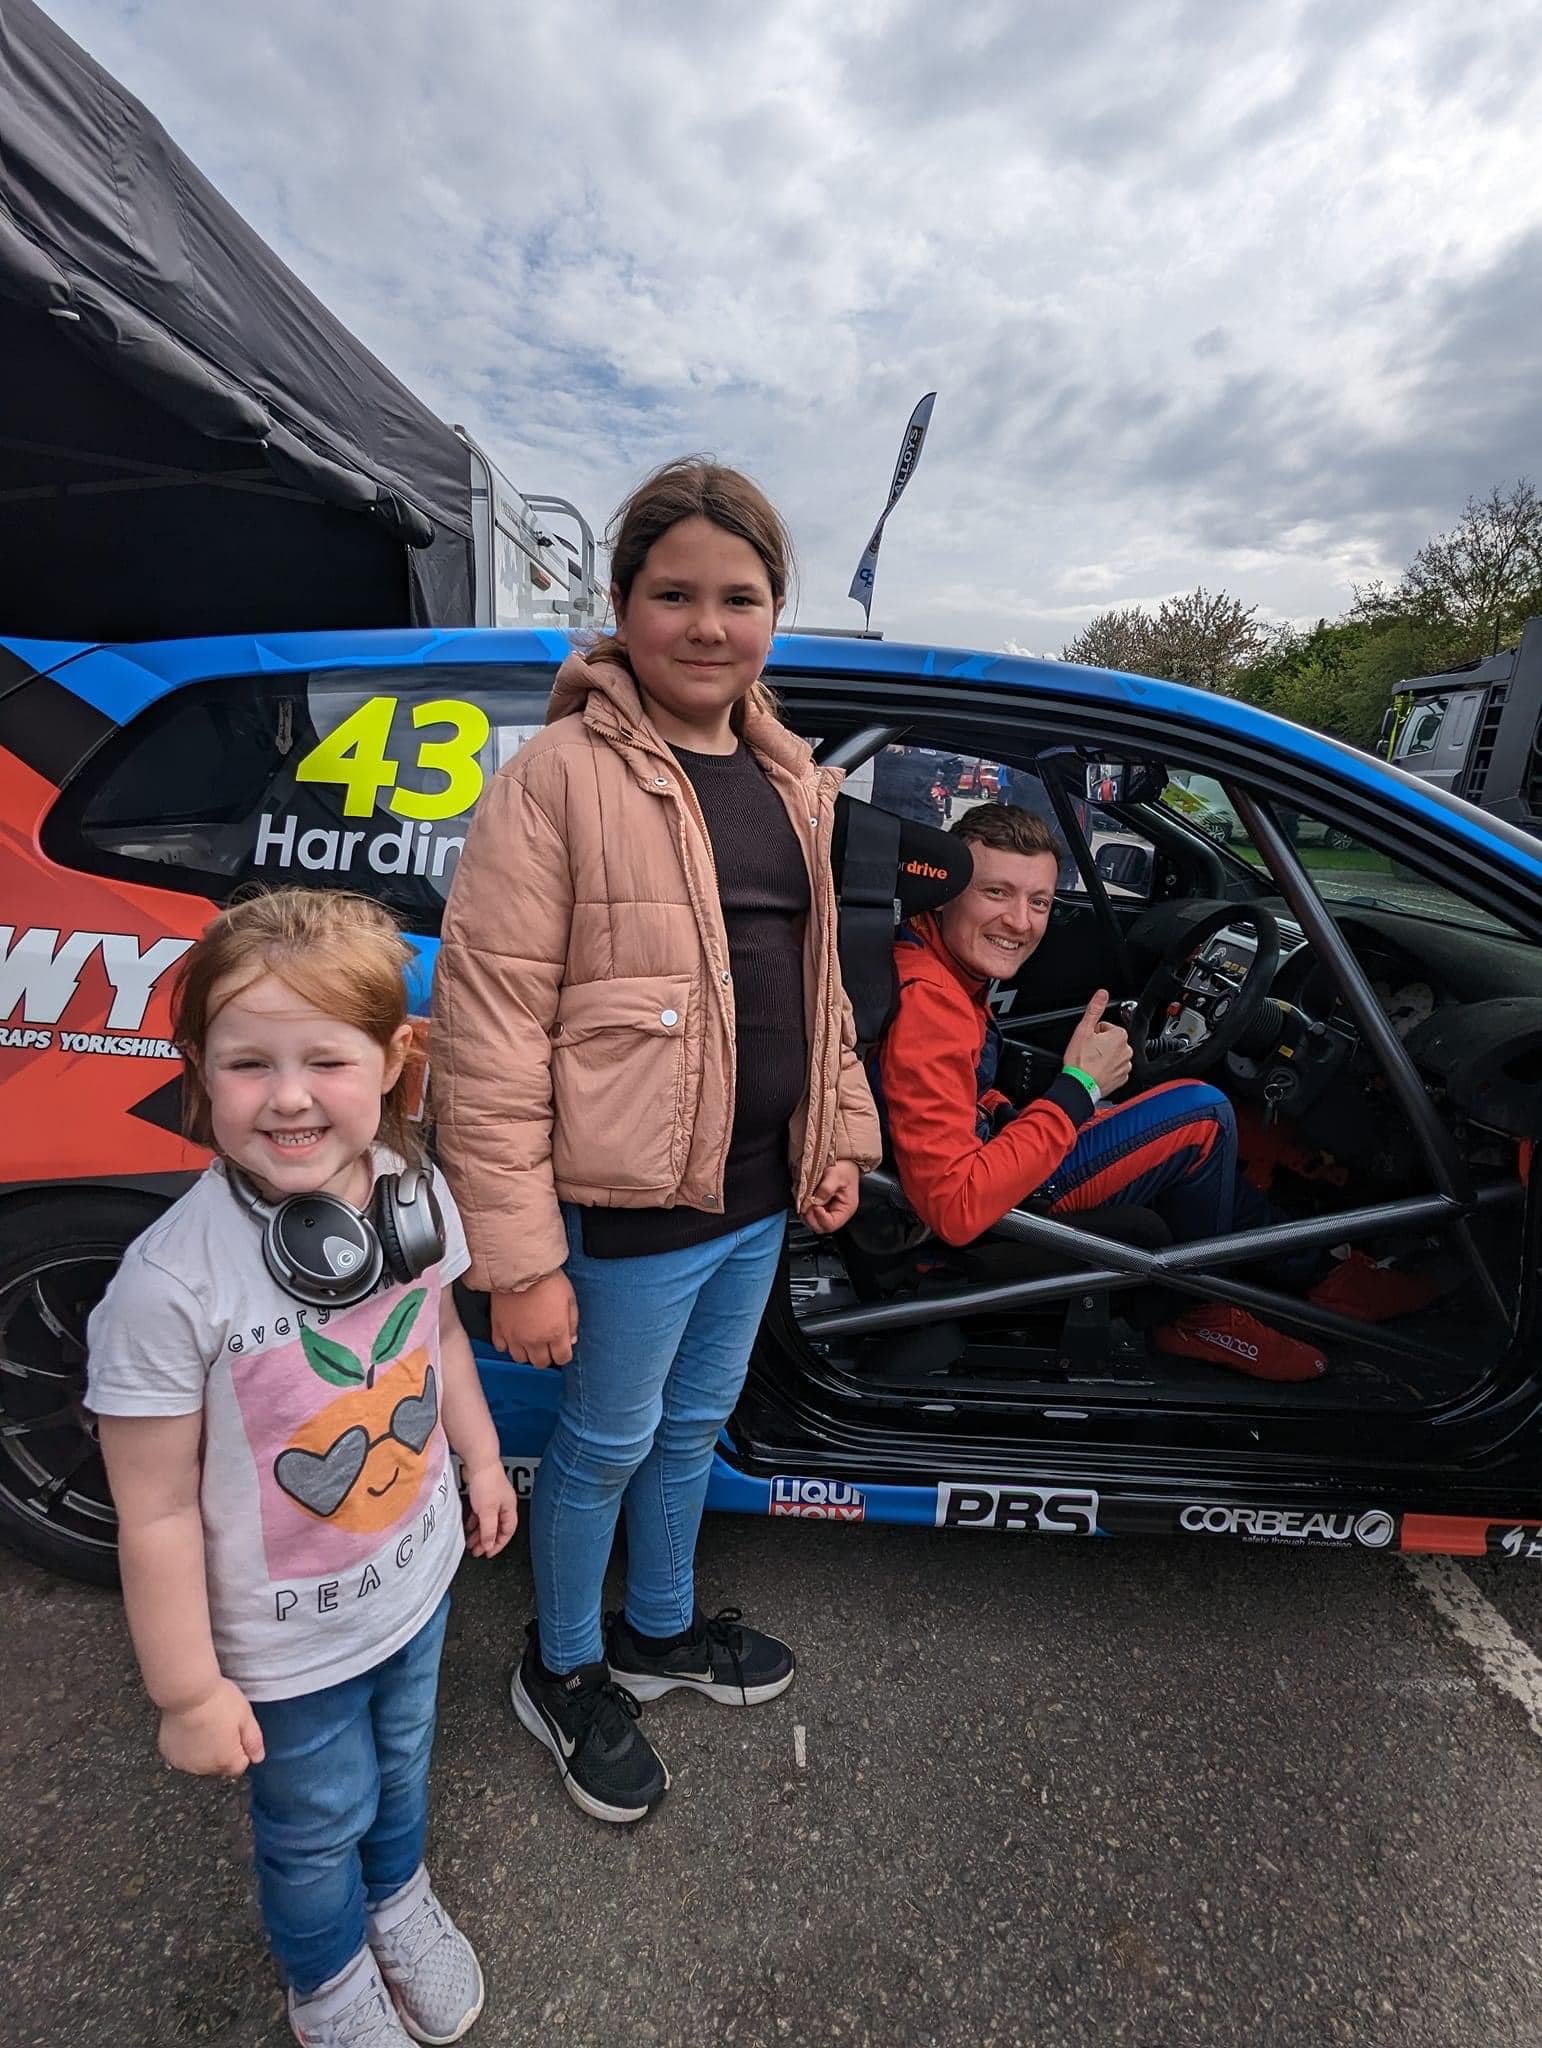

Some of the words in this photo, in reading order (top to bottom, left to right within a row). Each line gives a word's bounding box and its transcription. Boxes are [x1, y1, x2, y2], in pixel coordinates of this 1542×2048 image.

[894, 428, 919, 495] ALLOYS
[296, 696, 491, 821] 43
[0, 925, 198, 1032] WY
[1199, 1328, 1258, 1360] sparco
[775, 1479, 861, 1505] LIQUI
[1180, 1505, 1355, 1539] CORBEAU
[275, 1472, 449, 1622] PEACHY
